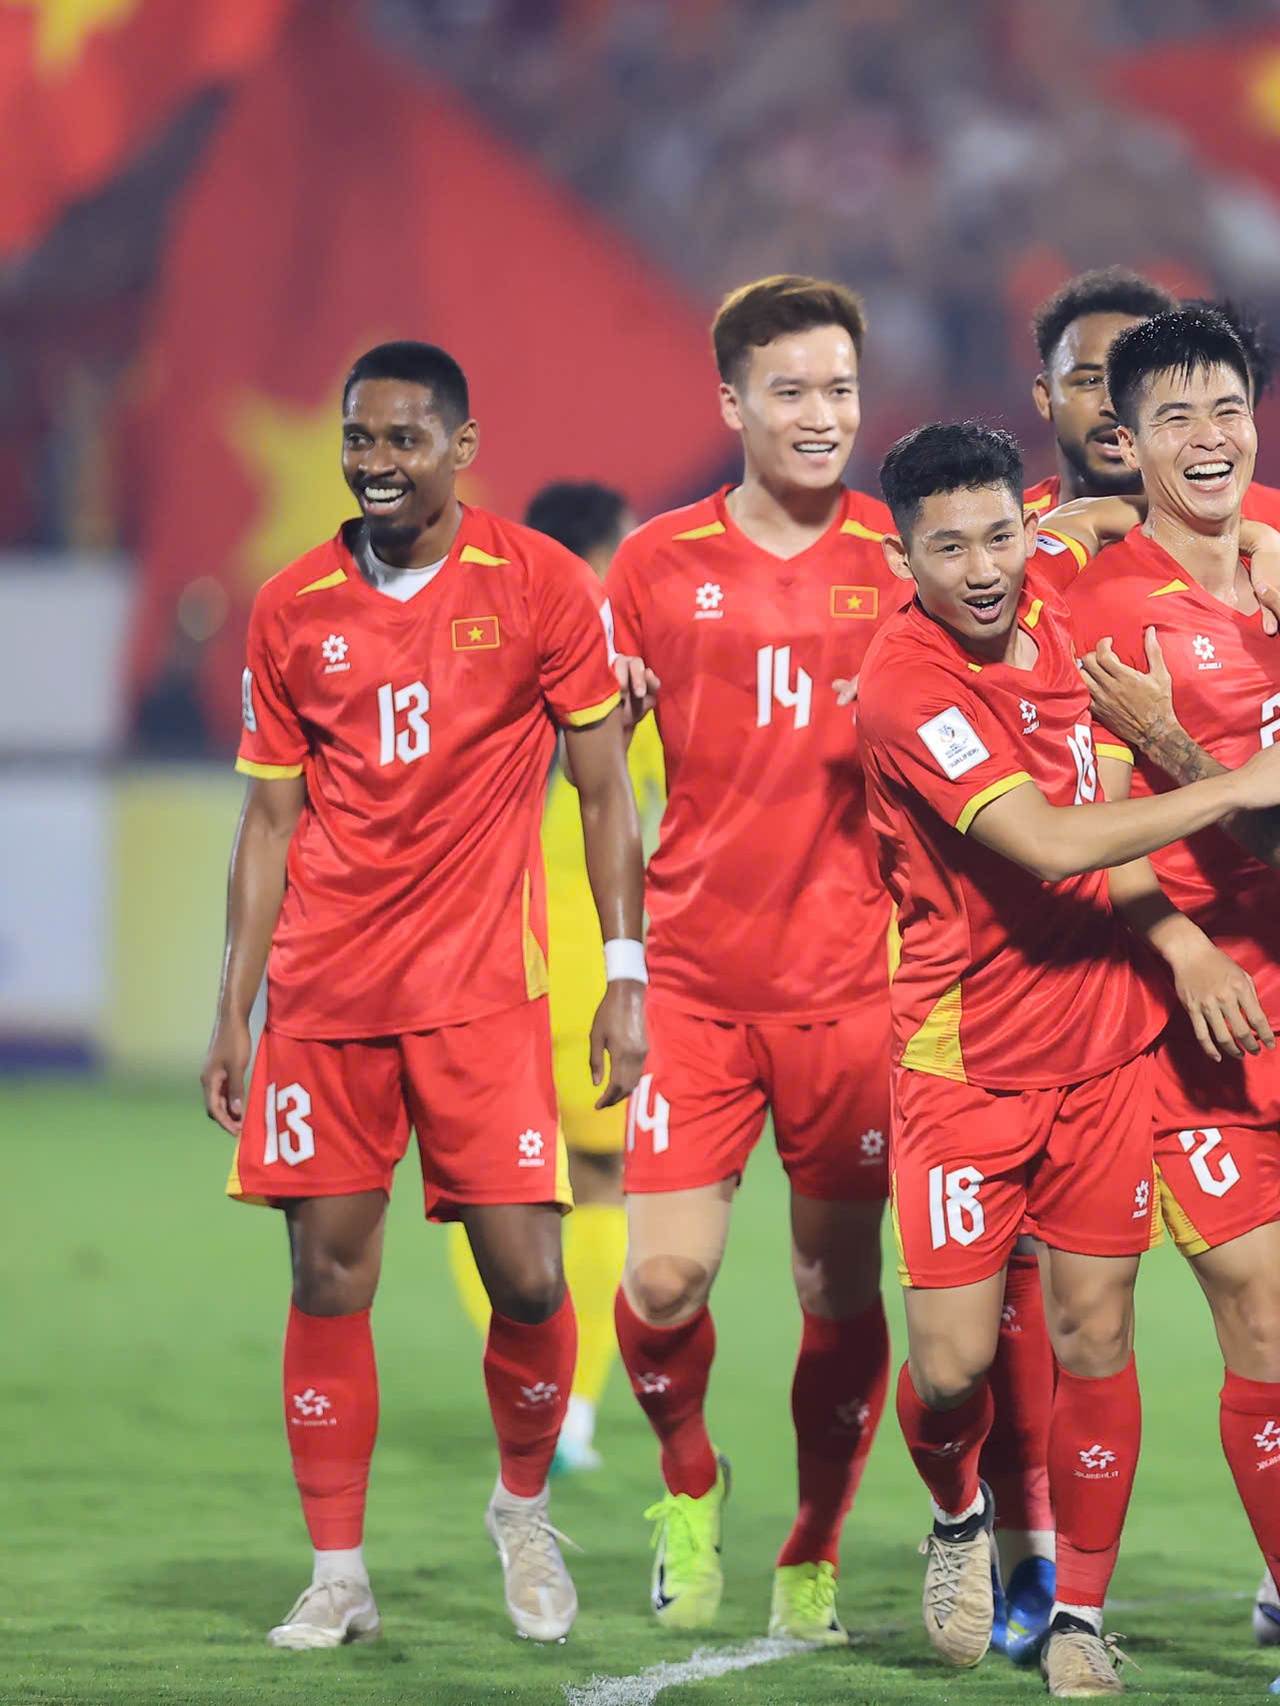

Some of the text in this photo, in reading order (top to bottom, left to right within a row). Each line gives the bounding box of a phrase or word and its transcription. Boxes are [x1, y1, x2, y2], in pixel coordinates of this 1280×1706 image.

[377, 680, 431, 767] 13
[756, 644, 813, 730] 14
[1066, 723, 1098, 806] 18
[263, 1081, 315, 1167] 13
[626, 1073, 671, 1155] 14
[1178, 1126, 1242, 1198] 2
[928, 1163, 986, 1251] 18
